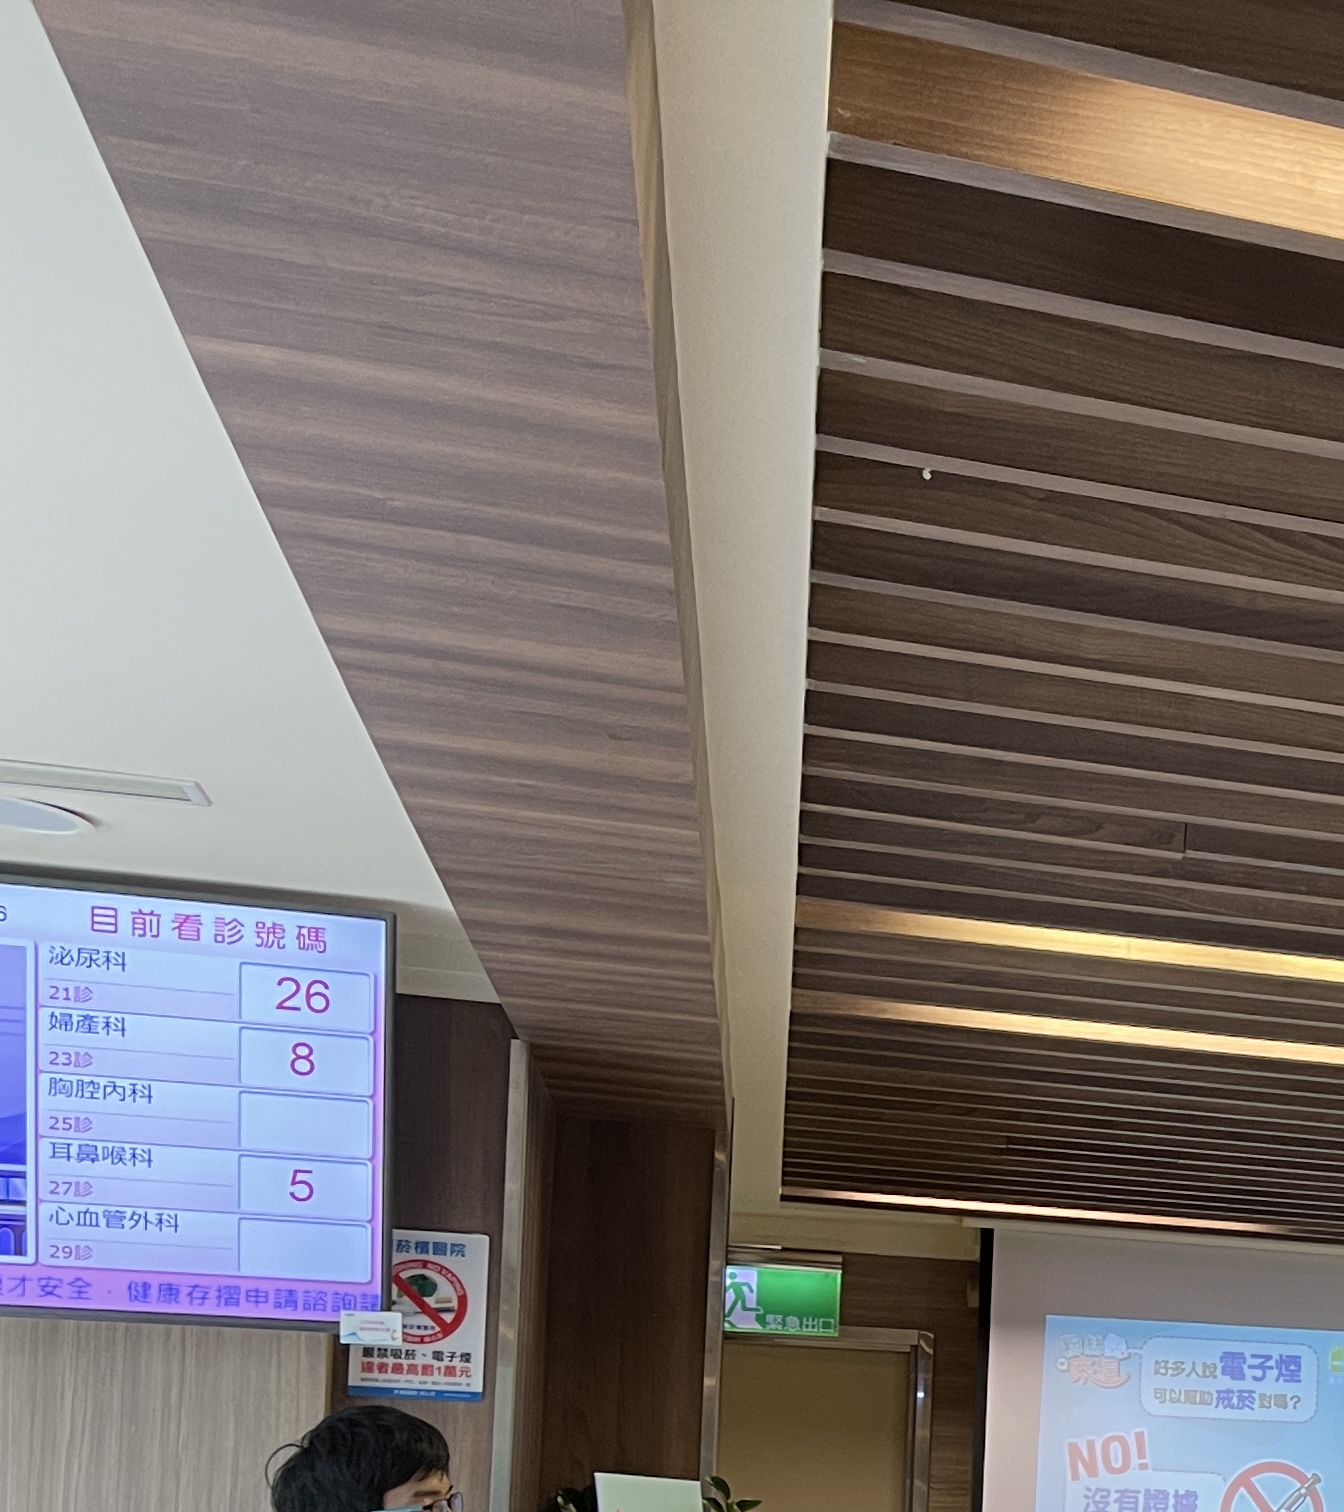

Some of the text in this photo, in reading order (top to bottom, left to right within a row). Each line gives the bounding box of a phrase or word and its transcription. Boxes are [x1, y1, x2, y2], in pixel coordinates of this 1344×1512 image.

[90, 905, 328, 954] 目前看診號碼
[48, 946, 127, 972] 泌尿科
[275, 976, 331, 1014] 26
[48, 1011, 127, 1038] 婦產科
[289, 1041, 316, 1076] 8
[48, 1077, 154, 1105] 胸腔內科
[48, 1142, 154, 1169] 耳鼻喉科
[288, 1168, 315, 1202] 5
[48, 1206, 180, 1233] 心血管外科
[765, 1314, 835, 1332] 緊急出口
[1153, 1350, 1302, 1384] 好多人說電子煙
[1067, 1430, 1150, 1482] NO!
